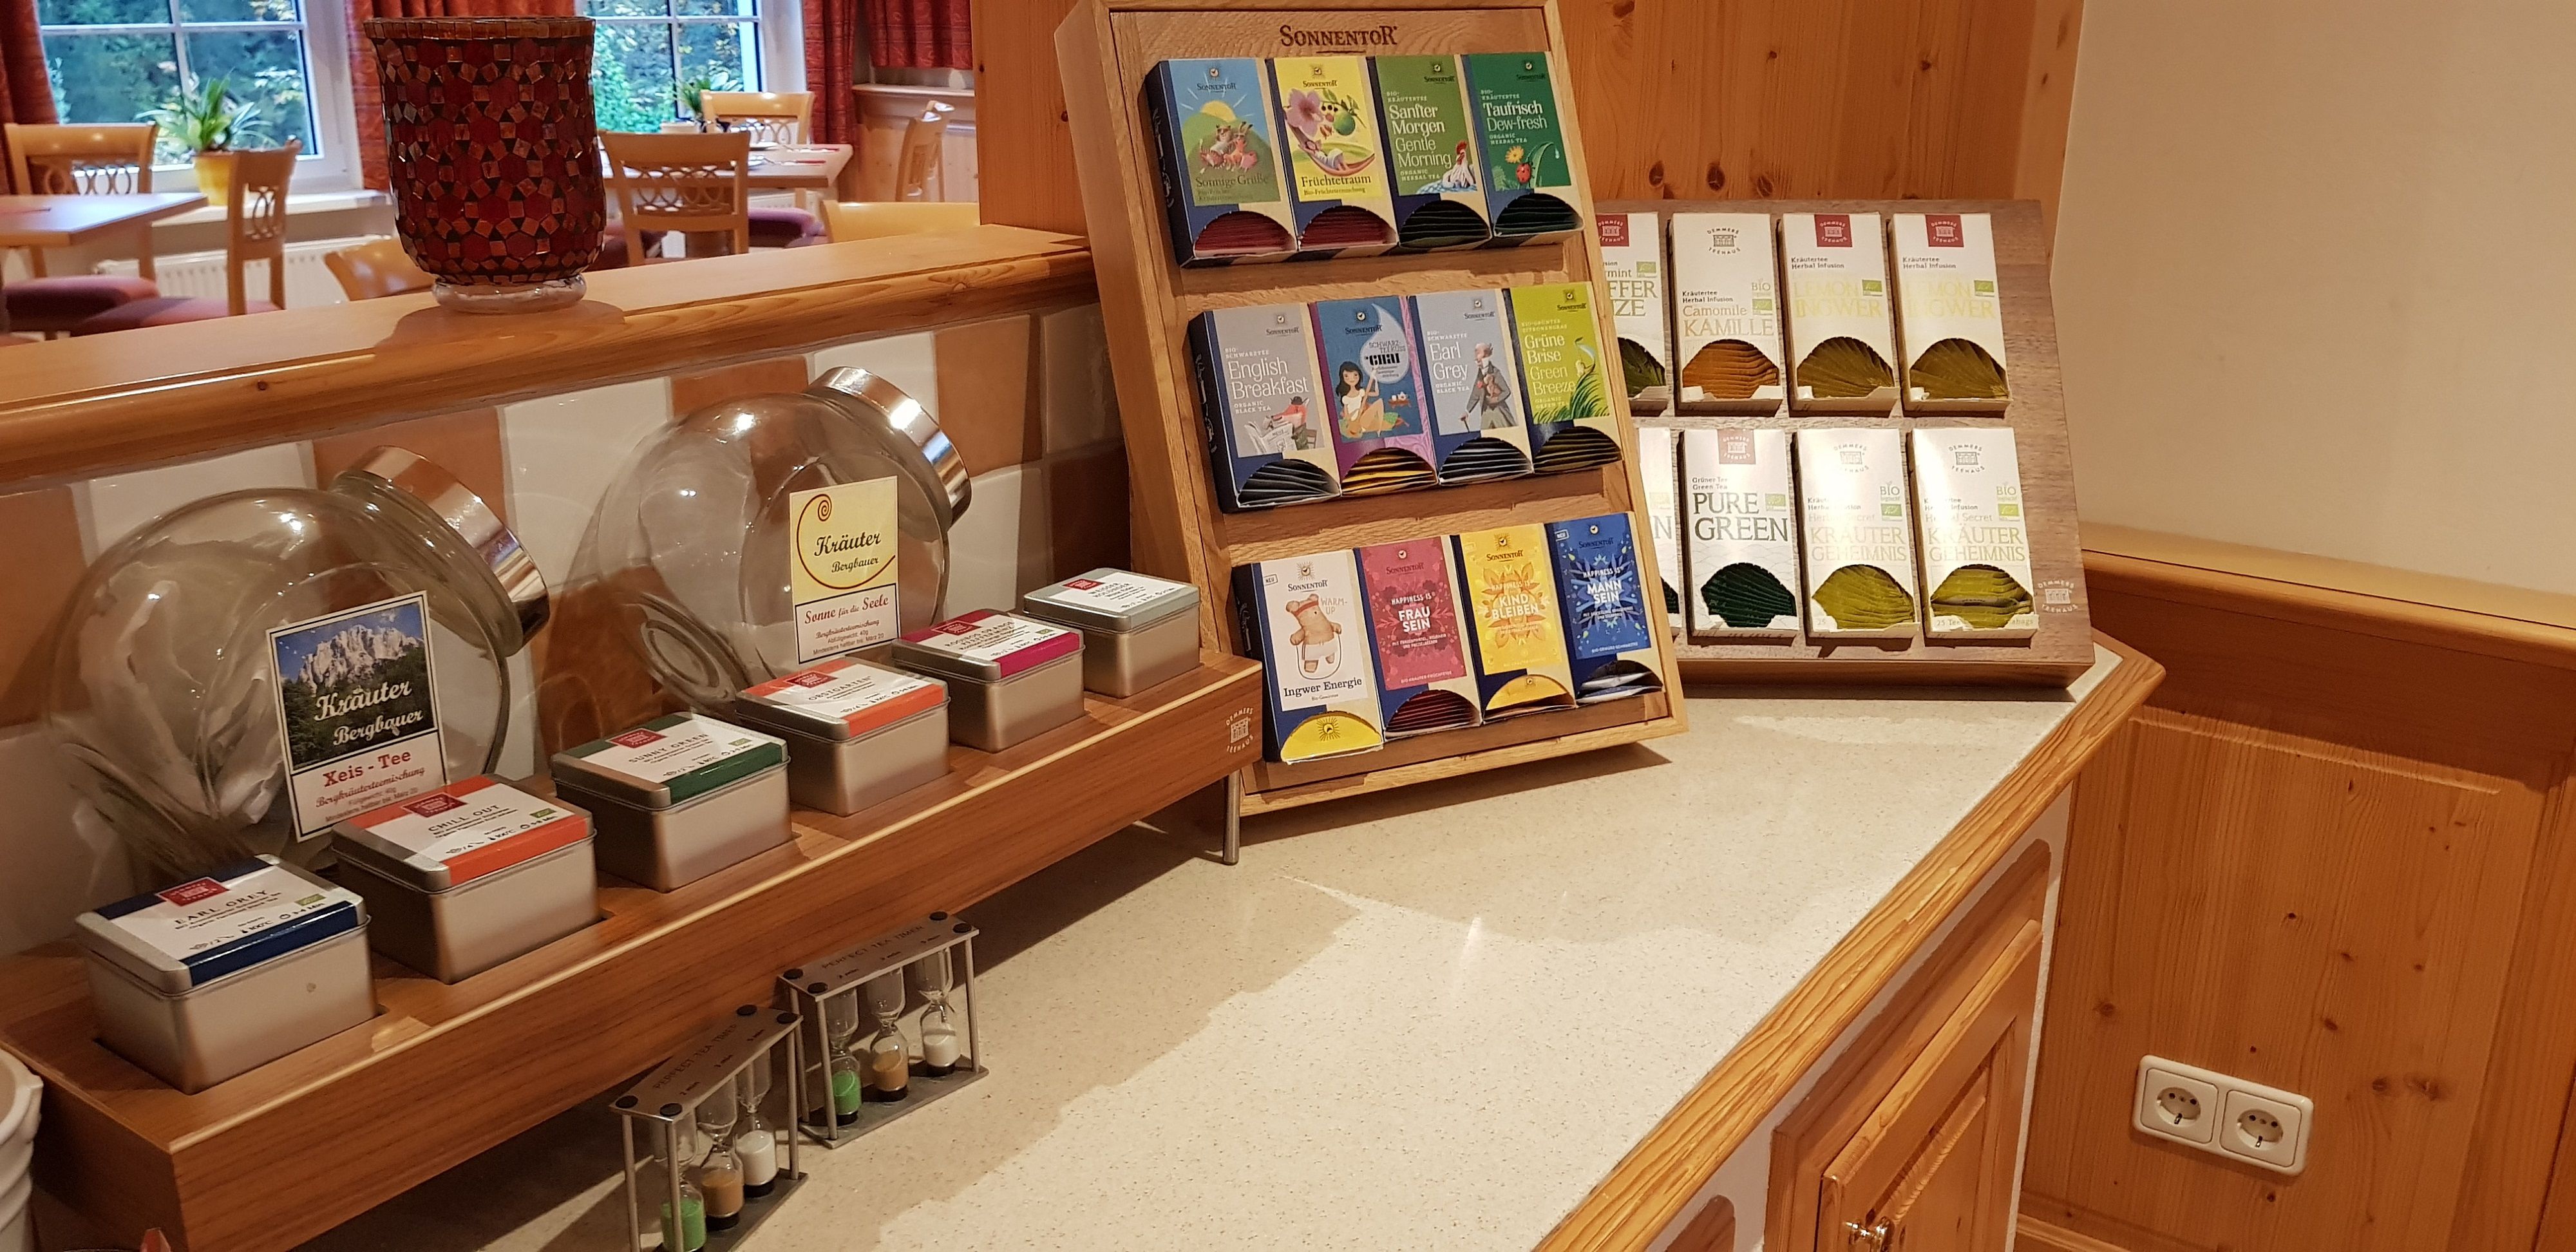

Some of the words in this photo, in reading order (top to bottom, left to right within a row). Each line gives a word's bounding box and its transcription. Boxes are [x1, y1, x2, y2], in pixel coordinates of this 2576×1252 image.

[1280, 24, 1397, 47] SONNENTOR
[1302, 79, 1338, 88] SONNENTOR
[1389, 103, 1439, 120] Sanfter
[1482, 100, 1544, 117] Taufrisch
[1392, 120, 1445, 137] Morgen
[1486, 116, 1548, 133] Dew-fresh
[1395, 136, 1436, 153] Gentle
[1397, 151, 1452, 168] Morning
[1301, 173, 1372, 188] Früchtetraum
[1604, 269, 1633, 278] mint
[1607, 280, 1659, 299] FFER
[1751, 281, 1772, 292] BIO
[1682, 305, 1748, 318] Camomile
[1683, 318, 1774, 337] KAMILLE
[1524, 334, 1566, 350] Grüne
[1429, 341, 1462, 361] Earl
[1527, 348, 1562, 365] Brise
[1228, 356, 1289, 383] English
[1432, 362, 1468, 381] Grey
[1530, 366, 1569, 381] Green
[1231, 376, 1309, 400] Breakfast
[1532, 381, 1577, 397] Breeze
[1234, 400, 1264, 408] ORGANIC
[1235, 406, 1257, 415] BLACK
[1880, 486, 1900, 497] BIO
[1997, 486, 2017, 497] BIO
[1692, 491, 1760, 515] PURE
[1962, 512, 1993, 523] Secret
[1694, 515, 1788, 542] GREEN
[813, 531, 882, 556] Kräuter
[1486, 549, 1524, 562] SONNENTOR
[1811, 545, 1907, 562] GEHEIMNIS
[1929, 545, 2026, 562] GEHEIMNIS
[831, 556, 880, 573] Bergbauer
[1385, 562, 1425, 575] SONNENTOR
[1582, 568, 1613, 578] HAPPINESS
[1287, 579, 1328, 592] SONNENTOR
[1491, 581, 1523, 592] HAPPINESS
[1587, 580, 1623, 594] MANN
[1320, 597, 1348, 606] WARM-
[1391, 593, 1424, 605] HAPPINESS
[1499, 593, 1530, 607] KIND
[1593, 592, 1620, 604] SEIN
[804, 609, 837, 625] Sonne
[838, 607, 849, 618] für
[849, 605, 860, 613] die
[862, 594, 889, 611] Seele
[1398, 605, 1431, 622] FRAU
[1492, 603, 1540, 620] BLEIBEN
[1402, 618, 1432, 633] SEIN
[1283, 684, 1321, 698] Ingwer
[1323, 676, 1363, 690] Energie
[314, 679, 413, 721] Kräuter
[333, 709, 424, 747] Bergbauer
[629, 748, 668, 763] SUNNY
[670, 732, 710, 748] GREEN
[323, 765, 364, 788] Xeis
[377, 751, 412, 769] Tee
[428, 815, 469, 833] CHILL
[473, 804, 501, 817] OUT
[174, 907, 220, 925] EARL
[225, 889, 269, 907] GREY
